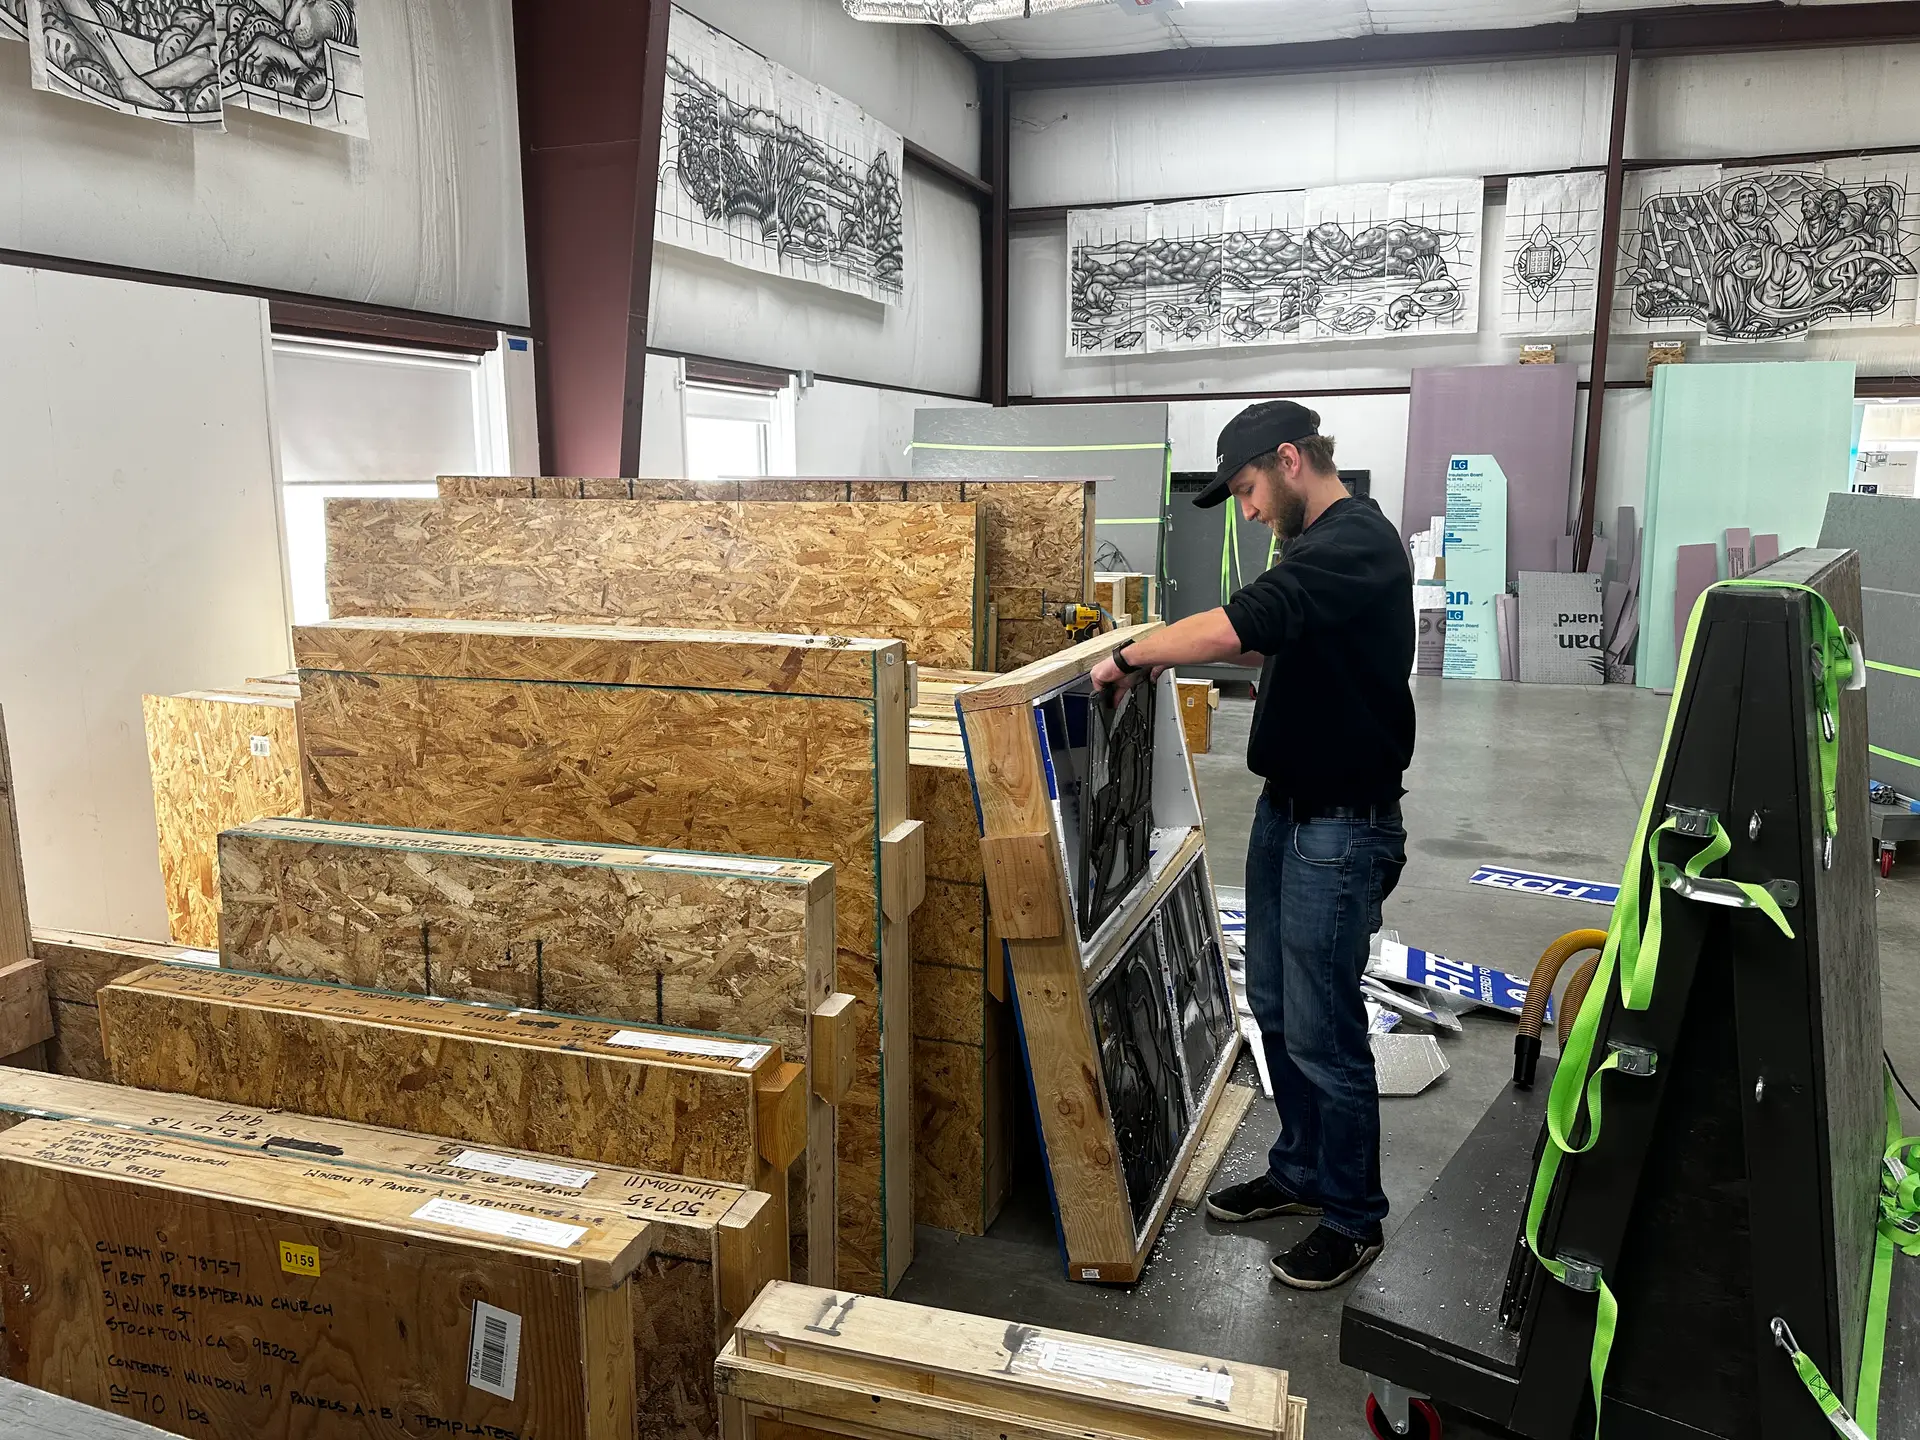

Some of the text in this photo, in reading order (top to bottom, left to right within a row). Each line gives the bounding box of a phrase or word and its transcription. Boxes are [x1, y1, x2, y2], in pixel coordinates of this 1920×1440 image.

[1453, 461, 1467, 470] LG
[1448, 611, 1462, 620] LG
[591, 1041, 641, 1051] CENTRAL
[59, 1136, 95, 1147] FIRST
[180, 1155, 229, 1168] CHURCH
[93, 1149, 122, 1159] VINE
[125, 1163, 167, 1178] 95202
[402, 1163, 477, 1181] PATRICK
[303, 1169, 354, 1183] WINDOW
[358, 1177, 375, 1187] 19
[379, 1181, 427, 1195] PANELS
[476, 1198, 565, 1218] TEMPLATES
[524, 1183, 582, 1198] CHURCH
[620, 1193, 705, 1217] 50735
[96, 1241, 241, 1277] CLIENT ID: 78757
[285, 1251, 315, 1268] 0159
[101, 1260, 334, 1317] FIRST PRESBYTERIAN CHURCH
[172, 1306, 196, 1324] ST.
[205, 1335, 228, 1349] CA
[252, 1336, 300, 1364] 95202
[107, 1354, 173, 1378] CONTENTS:
[183, 1369, 248, 1395] WINDOW
[259, 1383, 273, 1400] 19
[290, 1390, 349, 1413] PANELS
[353, 1402, 365, 1417] A
[416, 1414, 521, 1440] TEMPLATES
